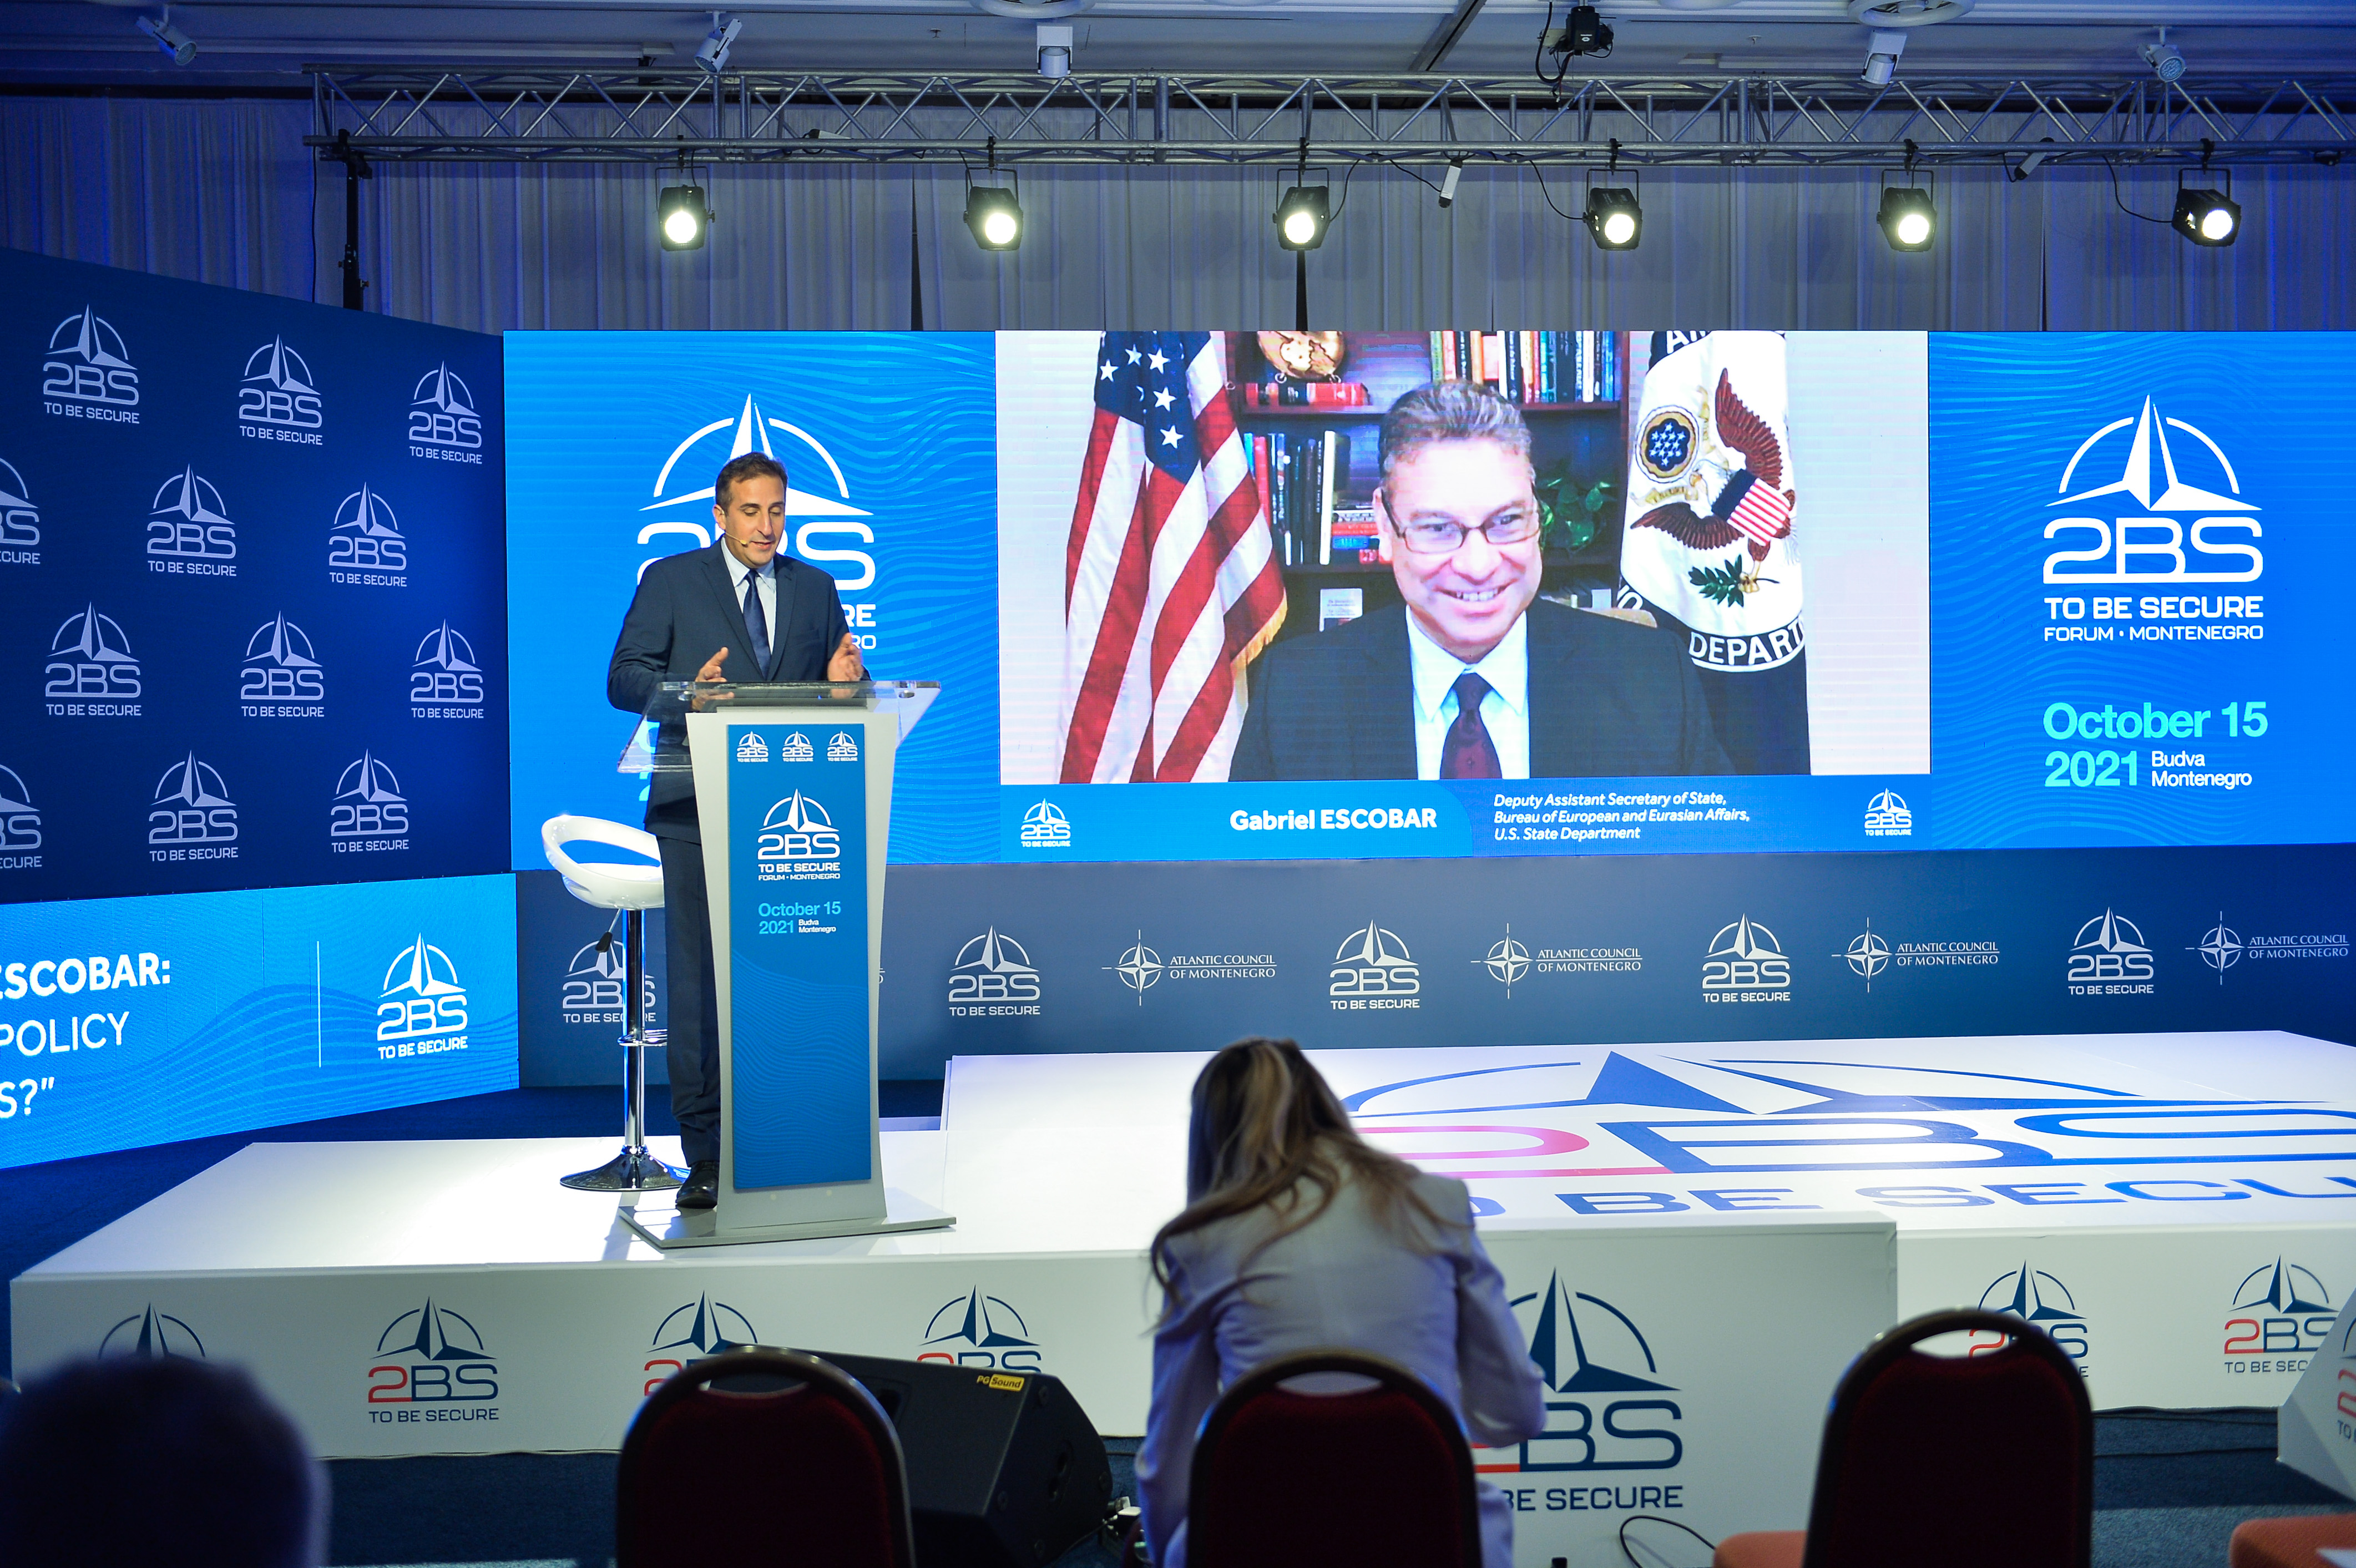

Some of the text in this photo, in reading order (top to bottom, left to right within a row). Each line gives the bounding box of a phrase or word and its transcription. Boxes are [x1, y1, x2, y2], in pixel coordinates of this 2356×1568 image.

[43, 362, 139, 405] 2BS
[44, 402, 139, 423] TO BE SECURE
[239, 388, 322, 428] 2BS
[240, 426, 322, 445] TO BE SECURE
[409, 411, 482, 448] 2BS
[409, 446, 482, 464] TO BE SECURE
[147, 522, 236, 559] 2BS
[328, 537, 407, 570] 2BS
[2043, 517, 2263, 584] 2BS
[148, 561, 236, 576] TO BE SECURE
[330, 573, 407, 586] TO BE SECURE
[2044, 596, 2263, 619] TO BE SECURE
[2045, 625, 2263, 641] FORUM MONTENEGRO
[45, 663, 141, 698] 2BS
[241, 669, 324, 700] 2BS
[411, 673, 483, 702] 2BS
[46, 704, 141, 716] TO BE SECURE
[241, 706, 324, 717] TO BE SECURE
[411, 708, 483, 718] TO BE SECURE
[2043, 701, 2268, 740] October 15
[737, 747, 769, 758] 2BS
[782, 747, 813, 757] 2BS
[827, 746, 858, 757] 2BS
[2151, 751, 2205, 767] Budva
[2045, 750, 2137, 786] 2021
[2151, 771, 2252, 789] Montenegro
[1494, 791, 1726, 810] Deputy Assistant Secretary of State,
[331, 804, 408, 837] 2BS
[1230, 808, 1437, 831] Gabriel ESCOBAR
[1494, 808, 1750, 826] Bureau of European and Eurasian Affairs,
[1864, 813, 1912, 828] 2BS
[149, 808, 238, 844] 2BS
[1021, 824, 1071, 839] 2BS
[1494, 826, 1640, 842] U.S. State Department
[332, 839, 409, 852] TO BE SECURE
[757, 833, 841, 859] 2BS
[150, 847, 238, 861] TO BE SECURE
[758, 862, 840, 873] TO BE SECURE
[758, 902, 841, 917] October 15
[759, 921, 794, 934] 2021
[1898, 942, 1998, 952] ATLANTIC COUNCIL
[2249, 935, 2347, 945] ATLANTIC COUNCIL
[1170, 955, 1275, 965] ATLANTIC COUNCIL
[1538, 948, 1640, 958] ATLANTIC COUNCIL
[1897, 955, 1998, 965] OF MONTENEGRO
[2249, 948, 2348, 958] OF MONTENEGRO
[1170, 968, 1275, 979] OF MONTENEGRO
[1538, 962, 1641, 972] OF MONTENEGRO
[1702, 961, 1790, 988] 2BS
[2068, 954, 2153, 981] 2BS
[949, 974, 1040, 1002] 2BS
[1329, 966, 1420, 995] 2BS
[1703, 992, 1790, 1002] TO BE SECURE
[2068, 985, 2153, 995] TO BE SECURE
[949, 1006, 1040, 1016] TO BE SECURE
[1331, 999, 1419, 1009] TO BE SECURE
[377, 995, 468, 1040] 2BS
[563, 1014, 580, 1022] TO
[584, 1014, 600, 1022] BE
[378, 1036, 468, 1059] TO BE SECURE
[1554, 1188, 1823, 1215] BE
[2224, 1362, 2245, 1373] TO
[2251, 1361, 2271, 1372] BE
[368, 1363, 499, 1403] 2BS
[992, 1377, 1022, 1388] Sound
[369, 1408, 499, 1423] TO BE SECURE
[1472, 1399, 1682, 1473] BS
[1546, 1485, 1683, 1510] SECURE
